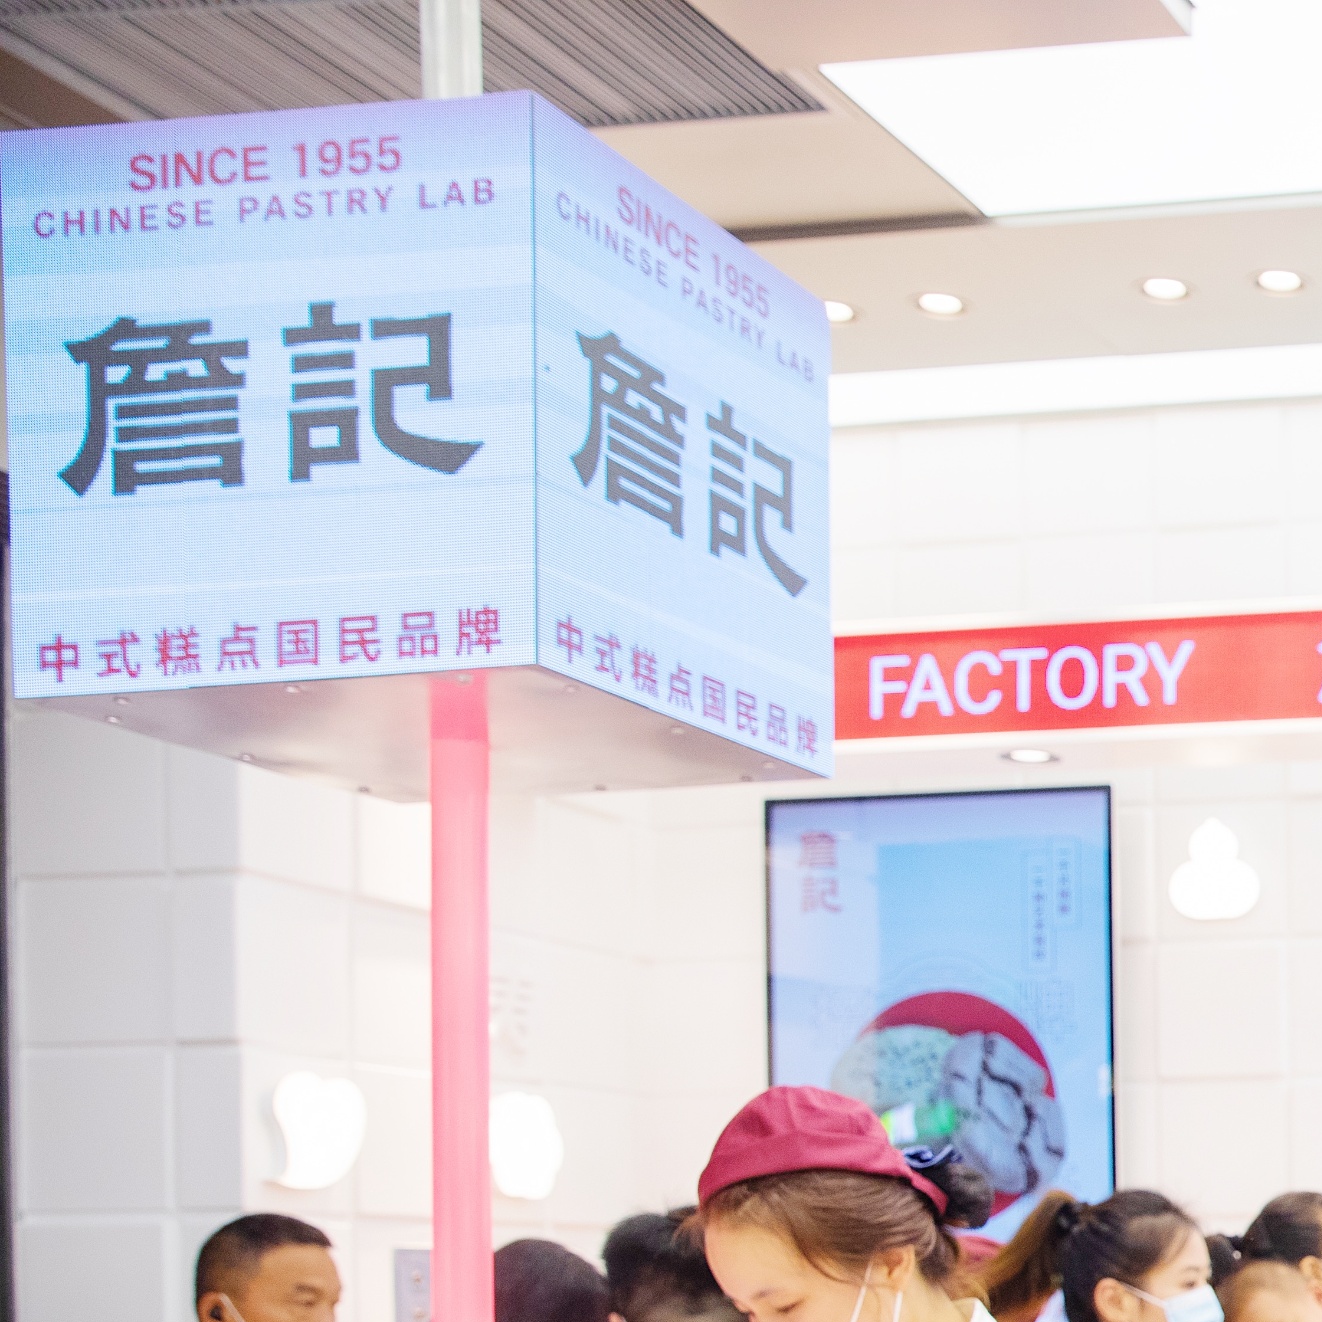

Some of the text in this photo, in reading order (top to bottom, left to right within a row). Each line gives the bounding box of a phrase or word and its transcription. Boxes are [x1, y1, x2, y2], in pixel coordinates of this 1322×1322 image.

[33, 177, 497, 240] CHINESE PASTRY LAB
[128, 135, 403, 194] SINCE 1955
[556, 191, 816, 384] CHINESE PASTRY LAB
[617, 185, 770, 320] SINCE 1955
[57, 300, 485, 497] 詹記
[571, 330, 808, 598] 詹記
[38, 605, 503, 684] 中式糕点国民品牌
[556, 615, 818, 758] 中式糕点国民品牌
[868, 639, 1196, 721] FACTORY
